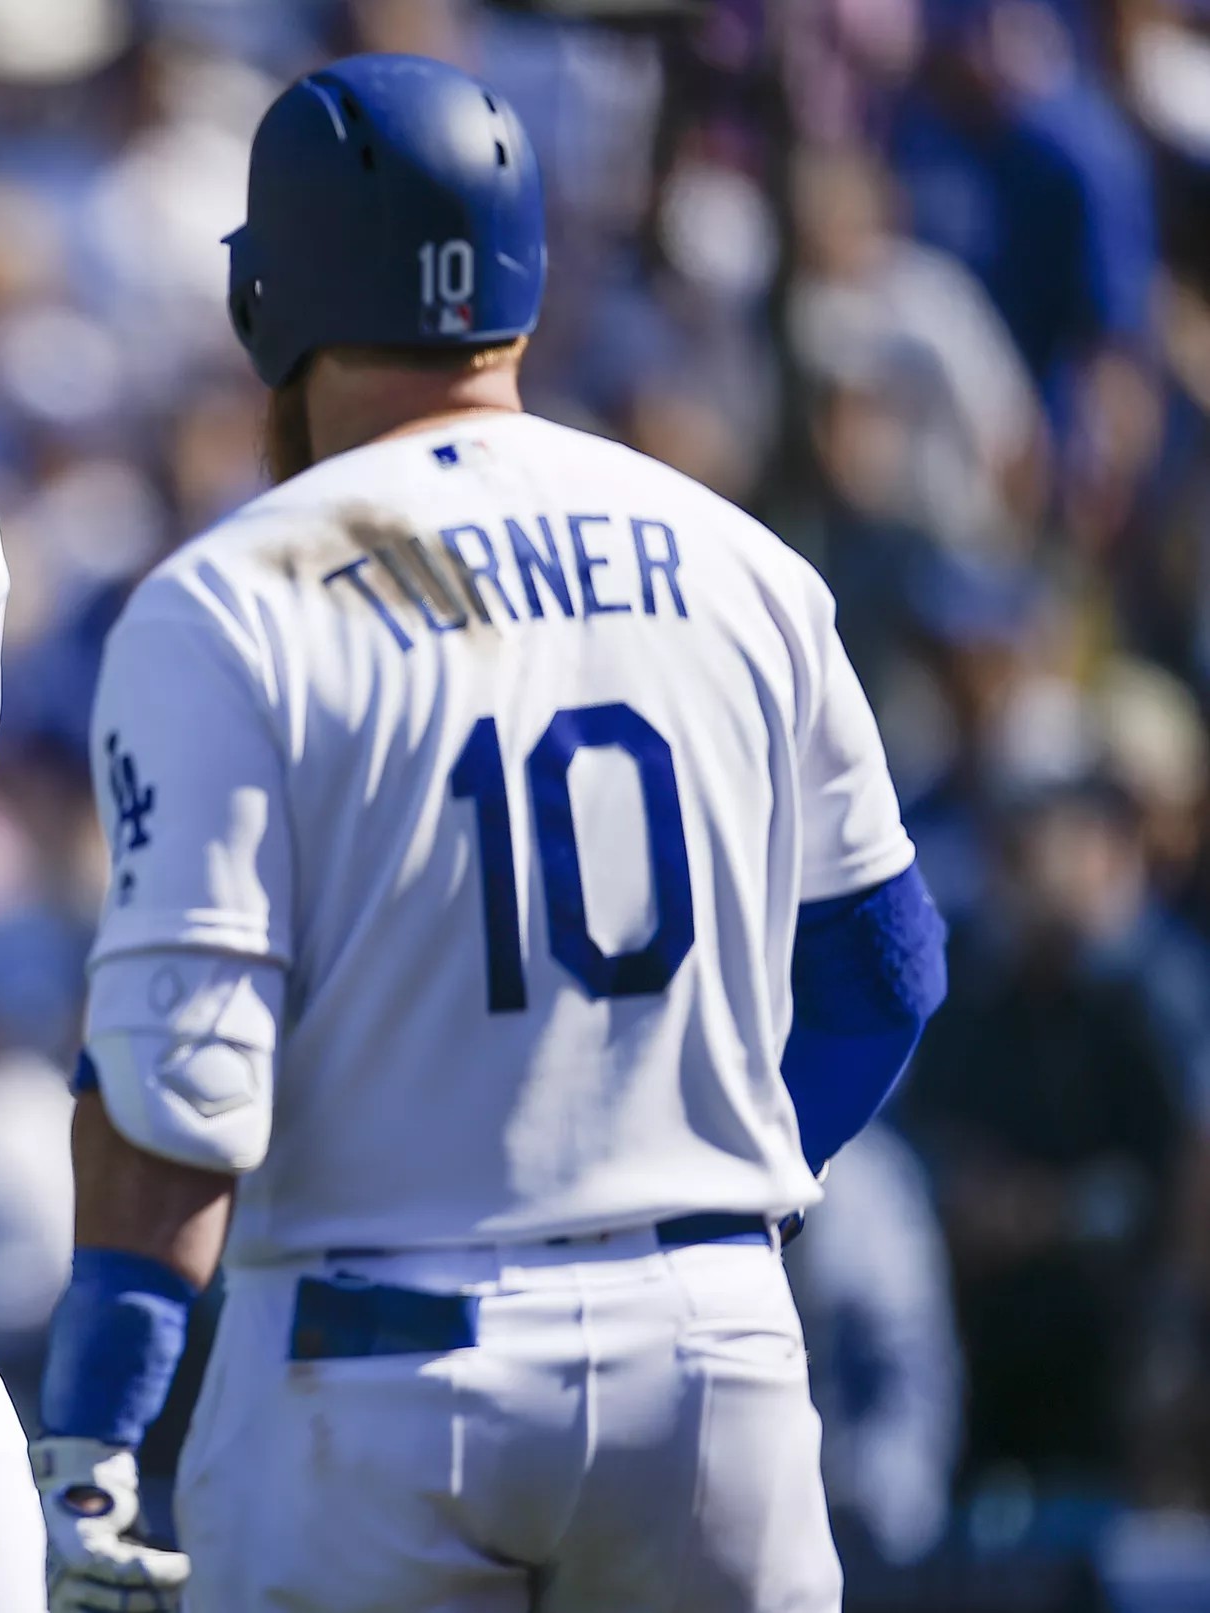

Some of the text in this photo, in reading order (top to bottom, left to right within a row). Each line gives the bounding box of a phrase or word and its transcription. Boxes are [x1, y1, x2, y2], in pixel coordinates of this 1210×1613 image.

[419, 240, 475, 306] 10
[322, 514, 688, 653] TURNER
[449, 701, 695, 1014] 10
